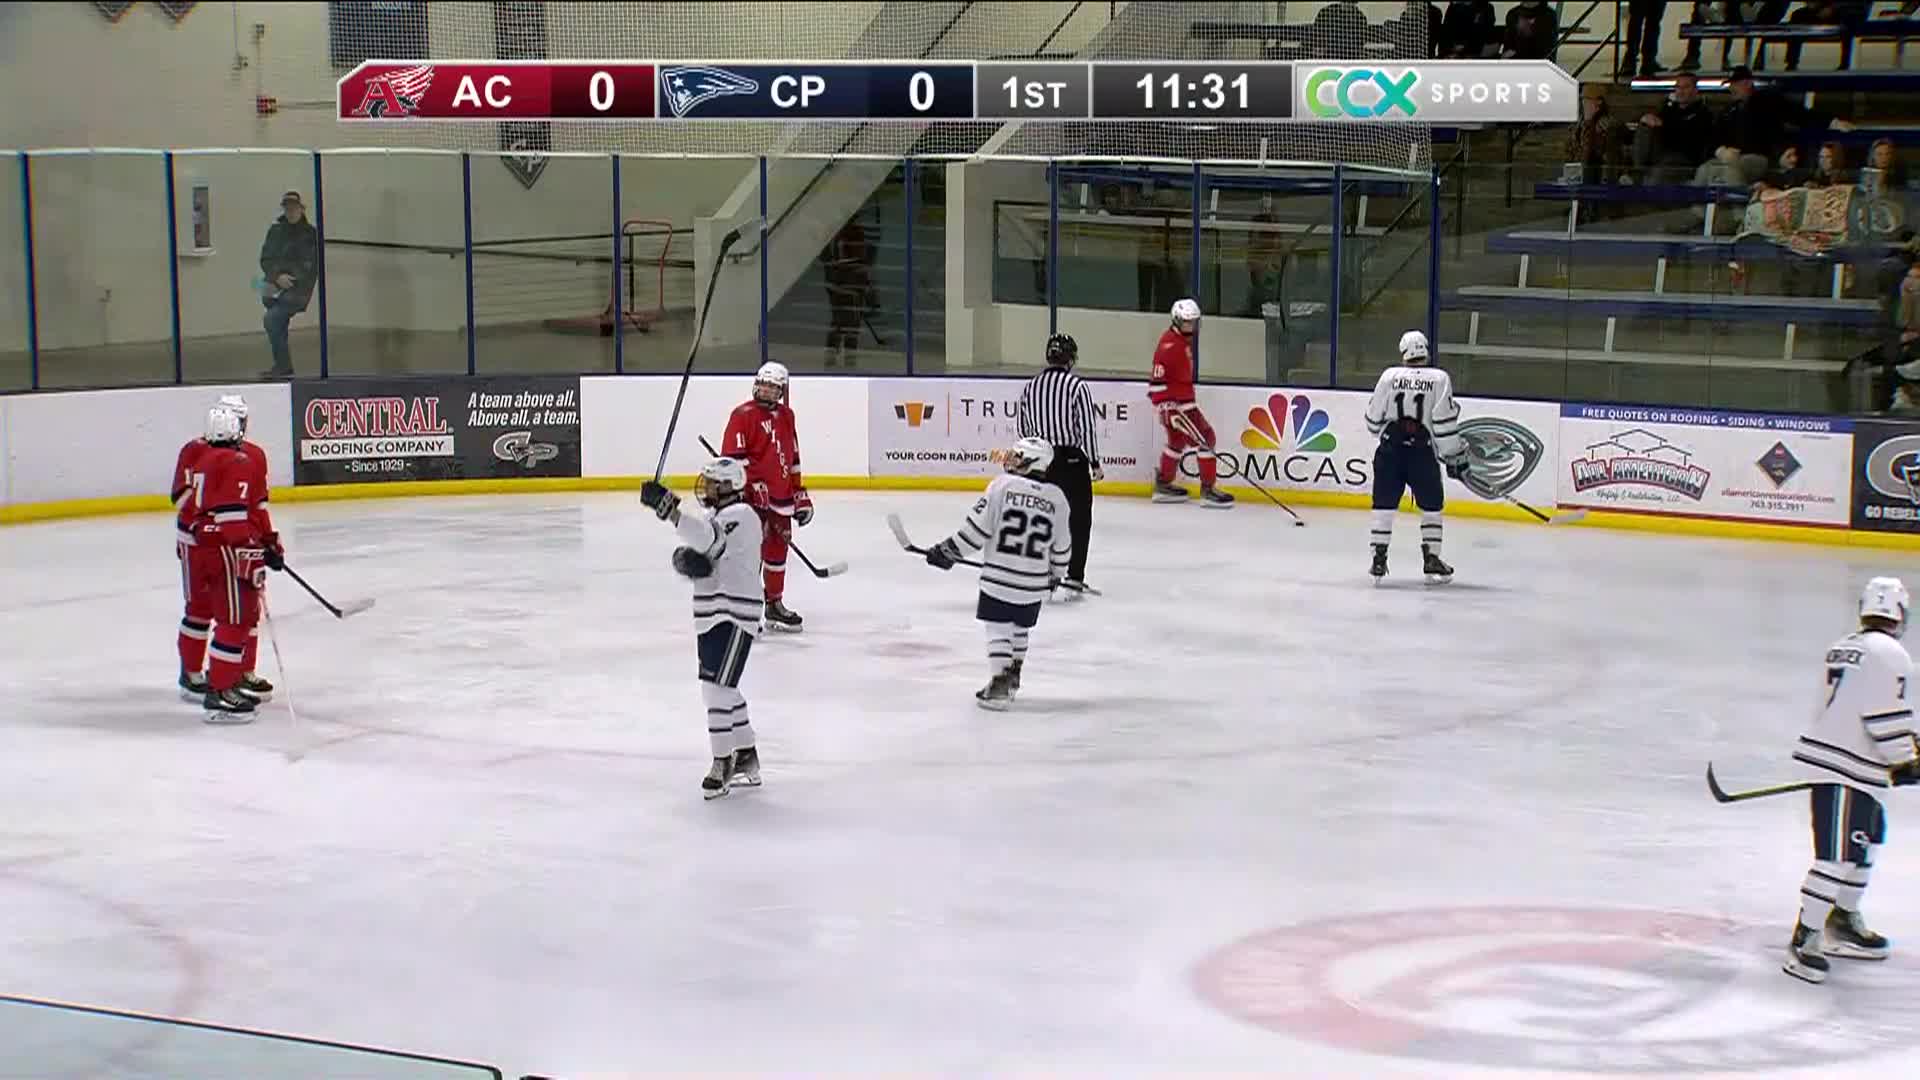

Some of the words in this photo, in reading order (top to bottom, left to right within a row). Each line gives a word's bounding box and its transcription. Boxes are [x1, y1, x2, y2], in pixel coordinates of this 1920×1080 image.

[1392, 378, 1434, 392] CARLSON
[467, 391, 478, 409] A
[480, 392, 513, 409] team
[514, 390, 555, 408] above
[556, 389, 577, 408] all.
[960, 398, 1129, 421] TRUNE
[1394, 391, 1425, 420] 11
[304, 397, 448, 438] CENTRAL
[467, 409, 509, 427] Above
[510, 408, 531, 427] all,
[532, 411, 542, 425] a
[543, 409, 581, 426] team.
[1581, 407, 1606, 418] FREE
[1607, 409, 1649, 421] QUOTES
[1651, 411, 1668, 422] ON
[1669, 413, 1719, 426] ROOFING
[1726, 417, 1766, 428] SIDING
[1774, 418, 1832, 432] WINDOWS
[311, 442, 374, 456] ROOFING
[375, 440, 446, 455] COMPANY
[885, 451, 915, 461] YOUR
[916, 451, 948, 461] COON
[949, 451, 988, 462] RAPIDS
[1103, 456, 1137, 466] UNION
[1179, 450, 1368, 486] COMCAS
[238, 481, 249, 499] 7
[1612, 459, 1704, 497] AMERICAN
[1005, 490, 1056, 516] PETERSON
[995, 508, 1054, 560] 22
[1826, 666, 1845, 709] 7
